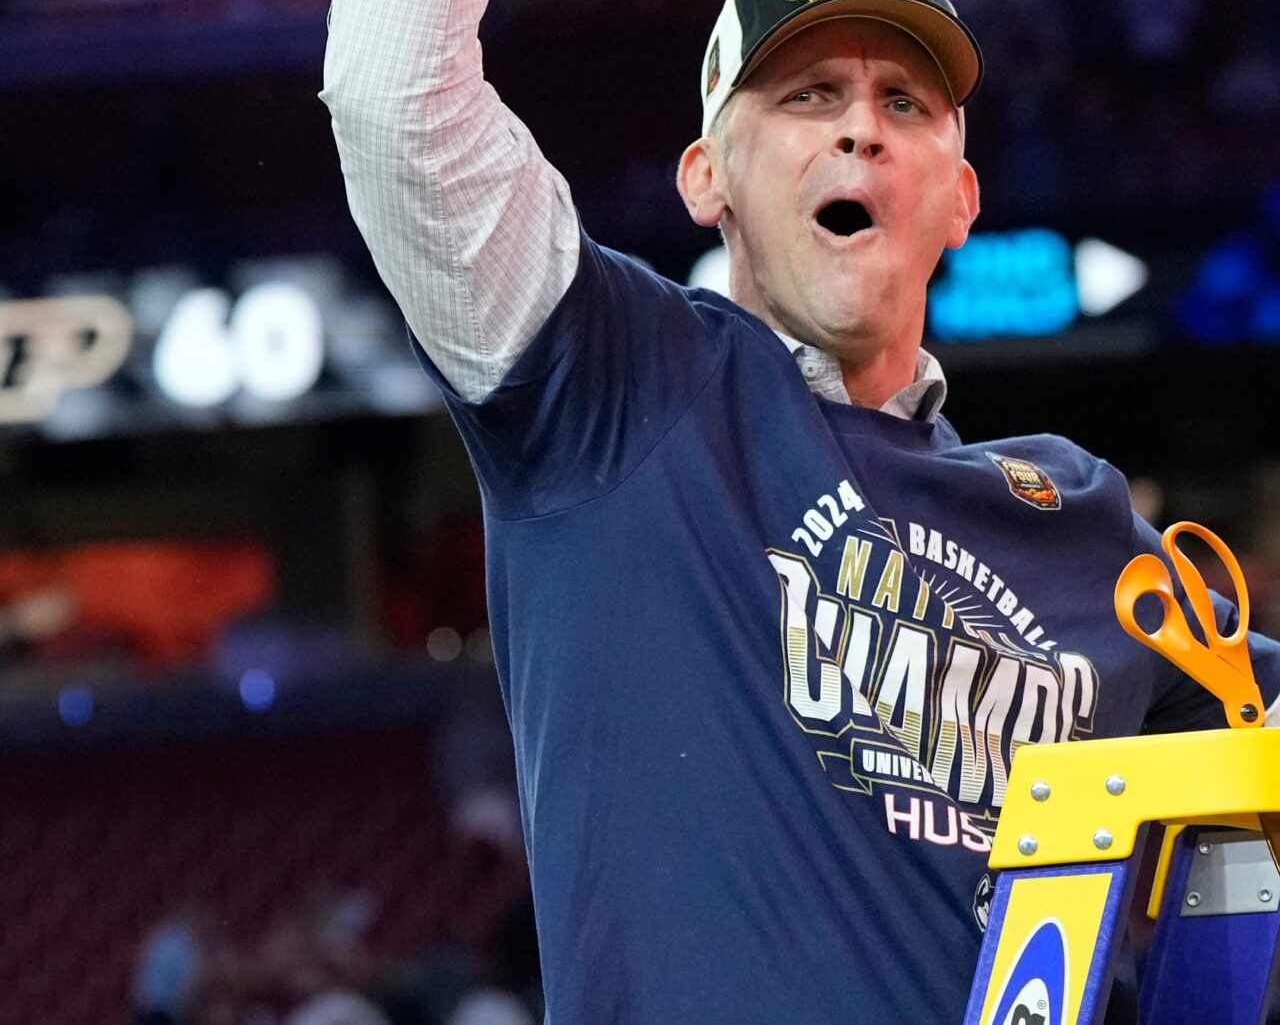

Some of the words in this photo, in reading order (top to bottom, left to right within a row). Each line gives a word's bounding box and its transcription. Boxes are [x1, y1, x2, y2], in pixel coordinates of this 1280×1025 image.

[154, 280, 324, 408] 60
[1009, 470, 1042, 485] FOUR
[791, 479, 865, 557] 2024
[909, 522, 1057, 650] BASKETBALL
[884, 793, 993, 852] HUS
